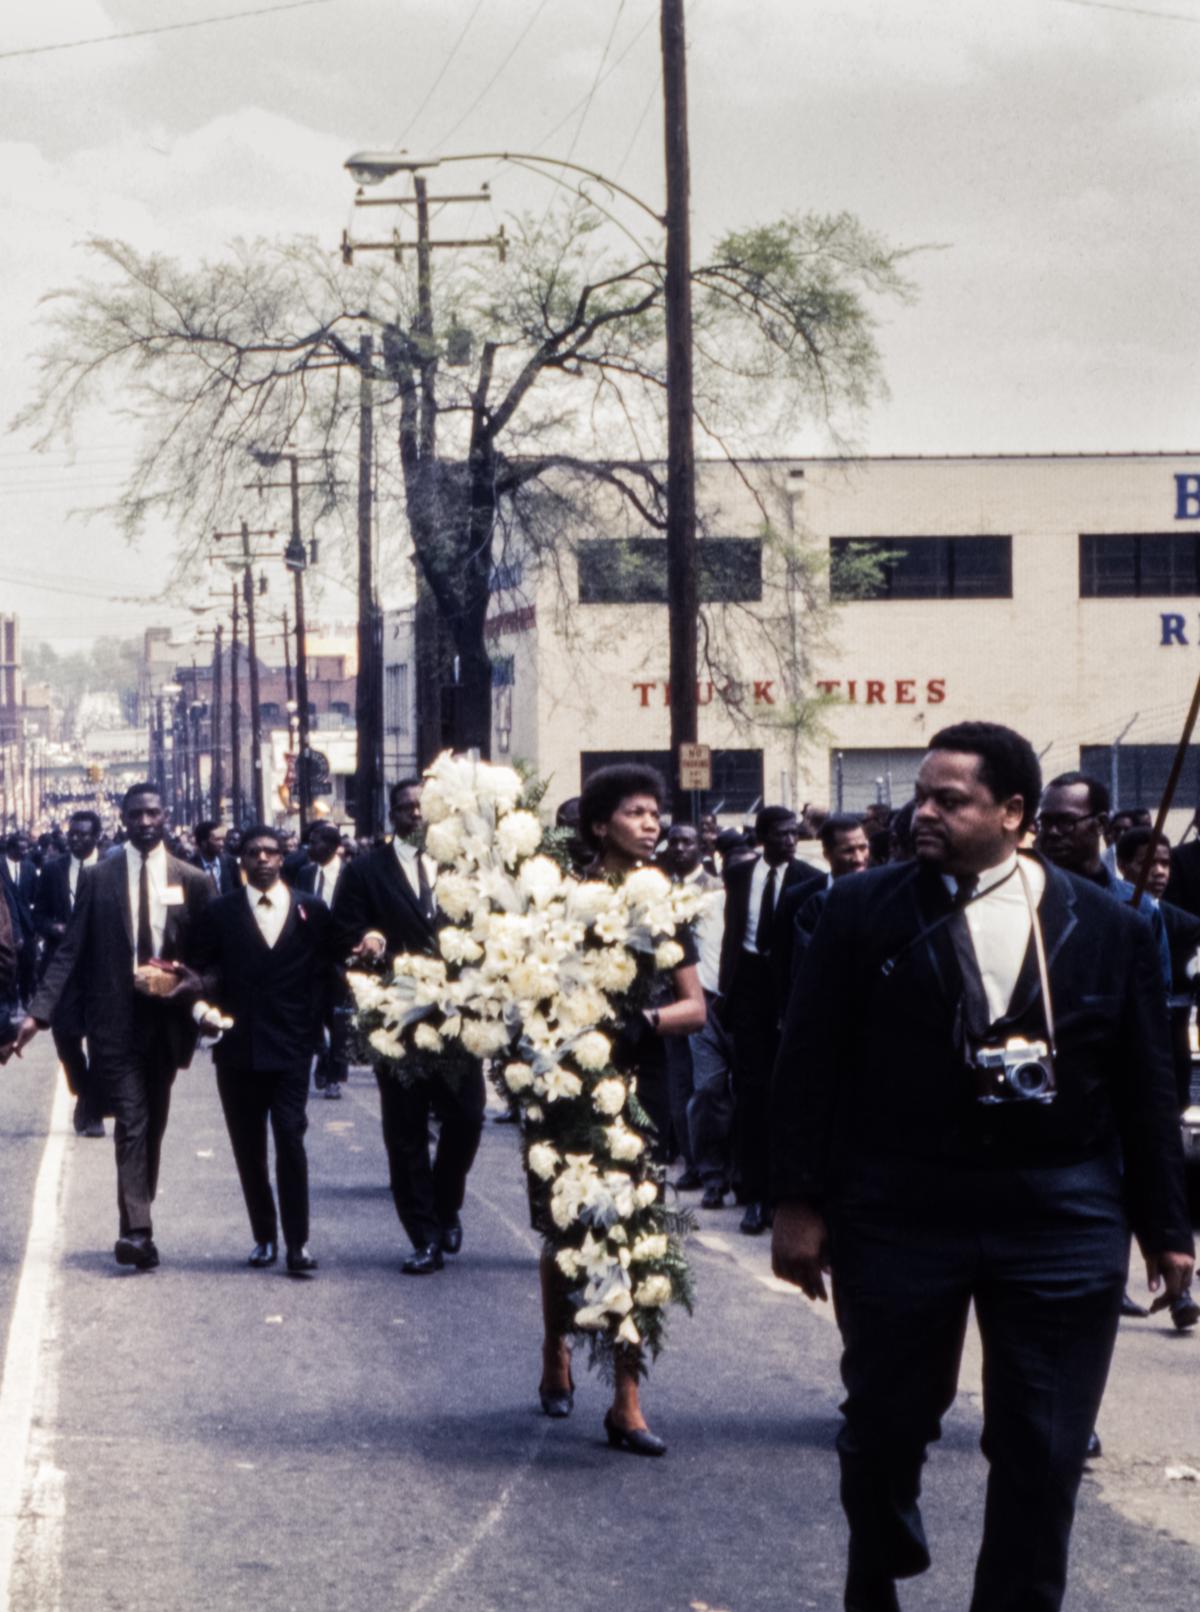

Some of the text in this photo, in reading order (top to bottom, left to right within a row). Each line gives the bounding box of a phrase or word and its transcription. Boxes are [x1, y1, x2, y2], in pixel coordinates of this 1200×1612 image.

[1160, 613, 1200, 646] R
[632, 679, 947, 707] TUCK TIRES
